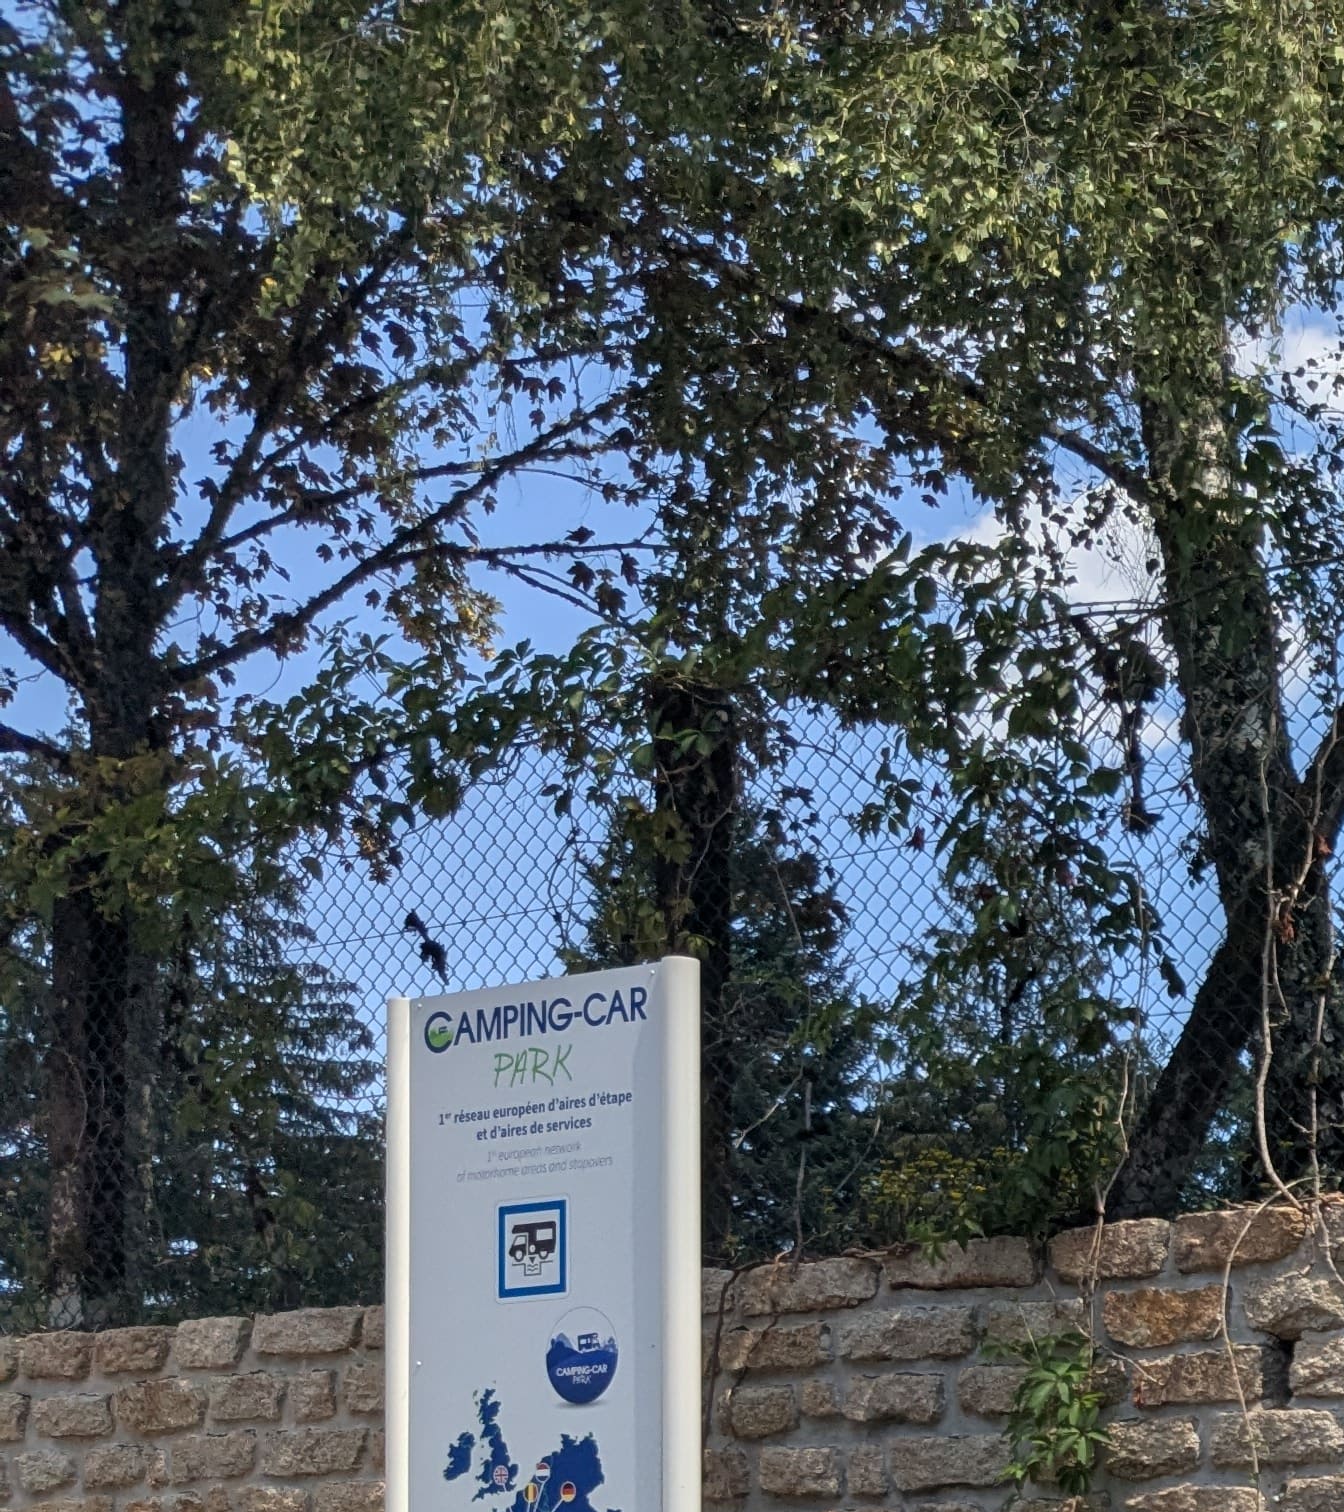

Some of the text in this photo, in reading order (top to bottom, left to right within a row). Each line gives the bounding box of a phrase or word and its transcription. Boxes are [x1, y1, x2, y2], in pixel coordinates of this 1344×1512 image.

[424, 986, 648, 1053] CAMPING-CAR
[494, 1044, 572, 1088] PARK
[454, 1108, 490, 1124] réseau
[493, 1101, 545, 1118] européen
[548, 1097, 586, 1112] d'aires
[589, 1092, 632, 1106] d'étape
[477, 1116, 592, 1140] et d'aires de services
[556, 1364, 608, 1376] CAMPING-CAR
